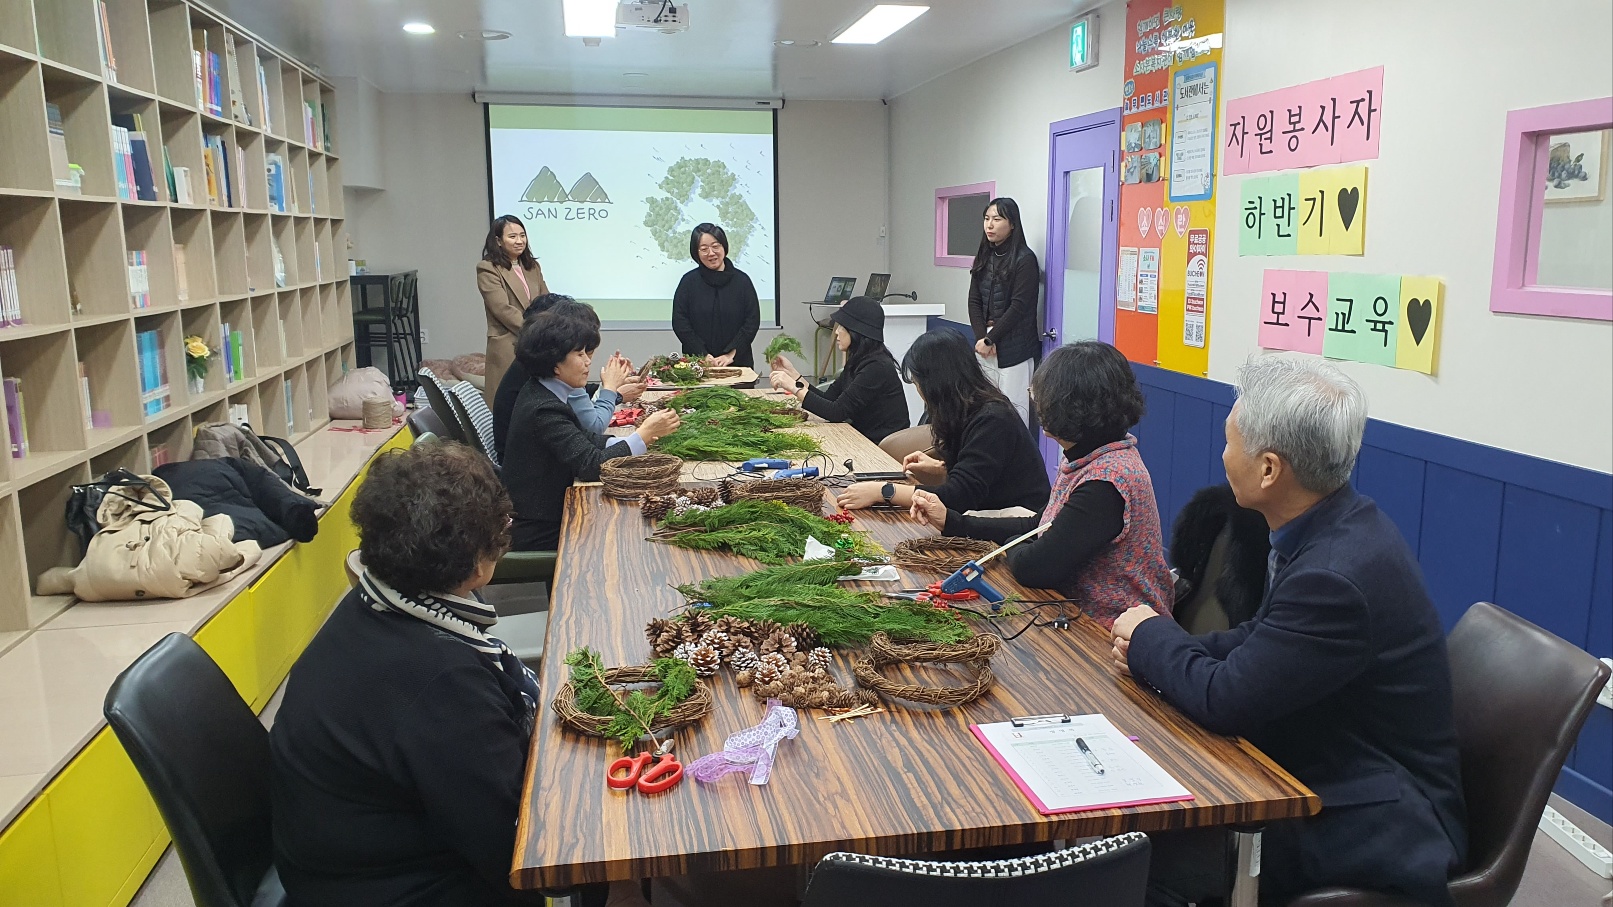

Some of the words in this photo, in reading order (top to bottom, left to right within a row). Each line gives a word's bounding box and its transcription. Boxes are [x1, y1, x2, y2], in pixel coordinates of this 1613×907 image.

[1180, 82, 1209, 99] 도서관에서는
[1227, 90, 1377, 158] 자원봉사자
[523, 206, 559, 220] SAN
[564, 207, 609, 221] ZERO
[1244, 190, 1326, 240] 하반기
[1190, 234, 1206, 244] 무료공공
[1189, 244, 1206, 254] 와이파이
[1263, 292, 1394, 347] 보수교육
